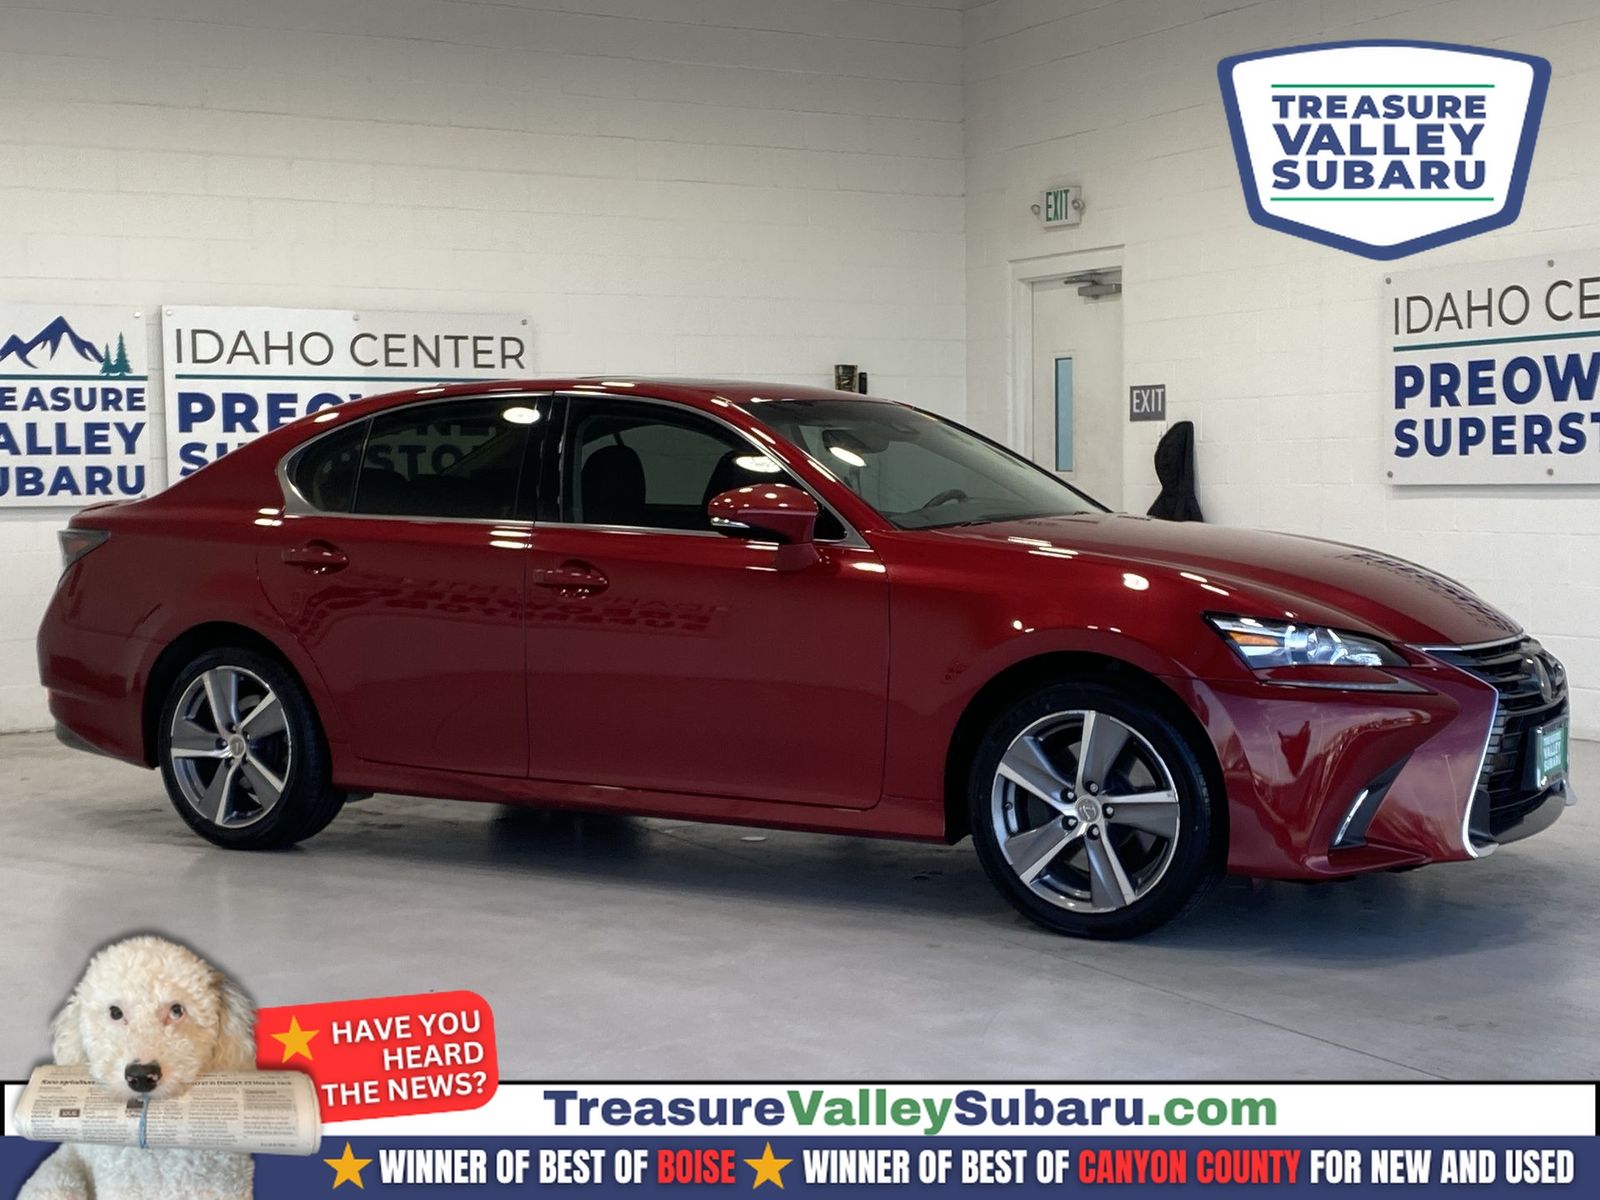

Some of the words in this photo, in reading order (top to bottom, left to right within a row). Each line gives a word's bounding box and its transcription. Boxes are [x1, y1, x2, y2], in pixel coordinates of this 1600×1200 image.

[1046, 189, 1070, 222] EXIT
[1394, 285, 1530, 335] IDAHO
[175, 329, 334, 366] IDAHO
[350, 333, 526, 370] CENTER
[1133, 388, 1164, 413] EXIT
[1394, 352, 1600, 410] PREOW
[1394, 412, 1600, 459] SUPERS
